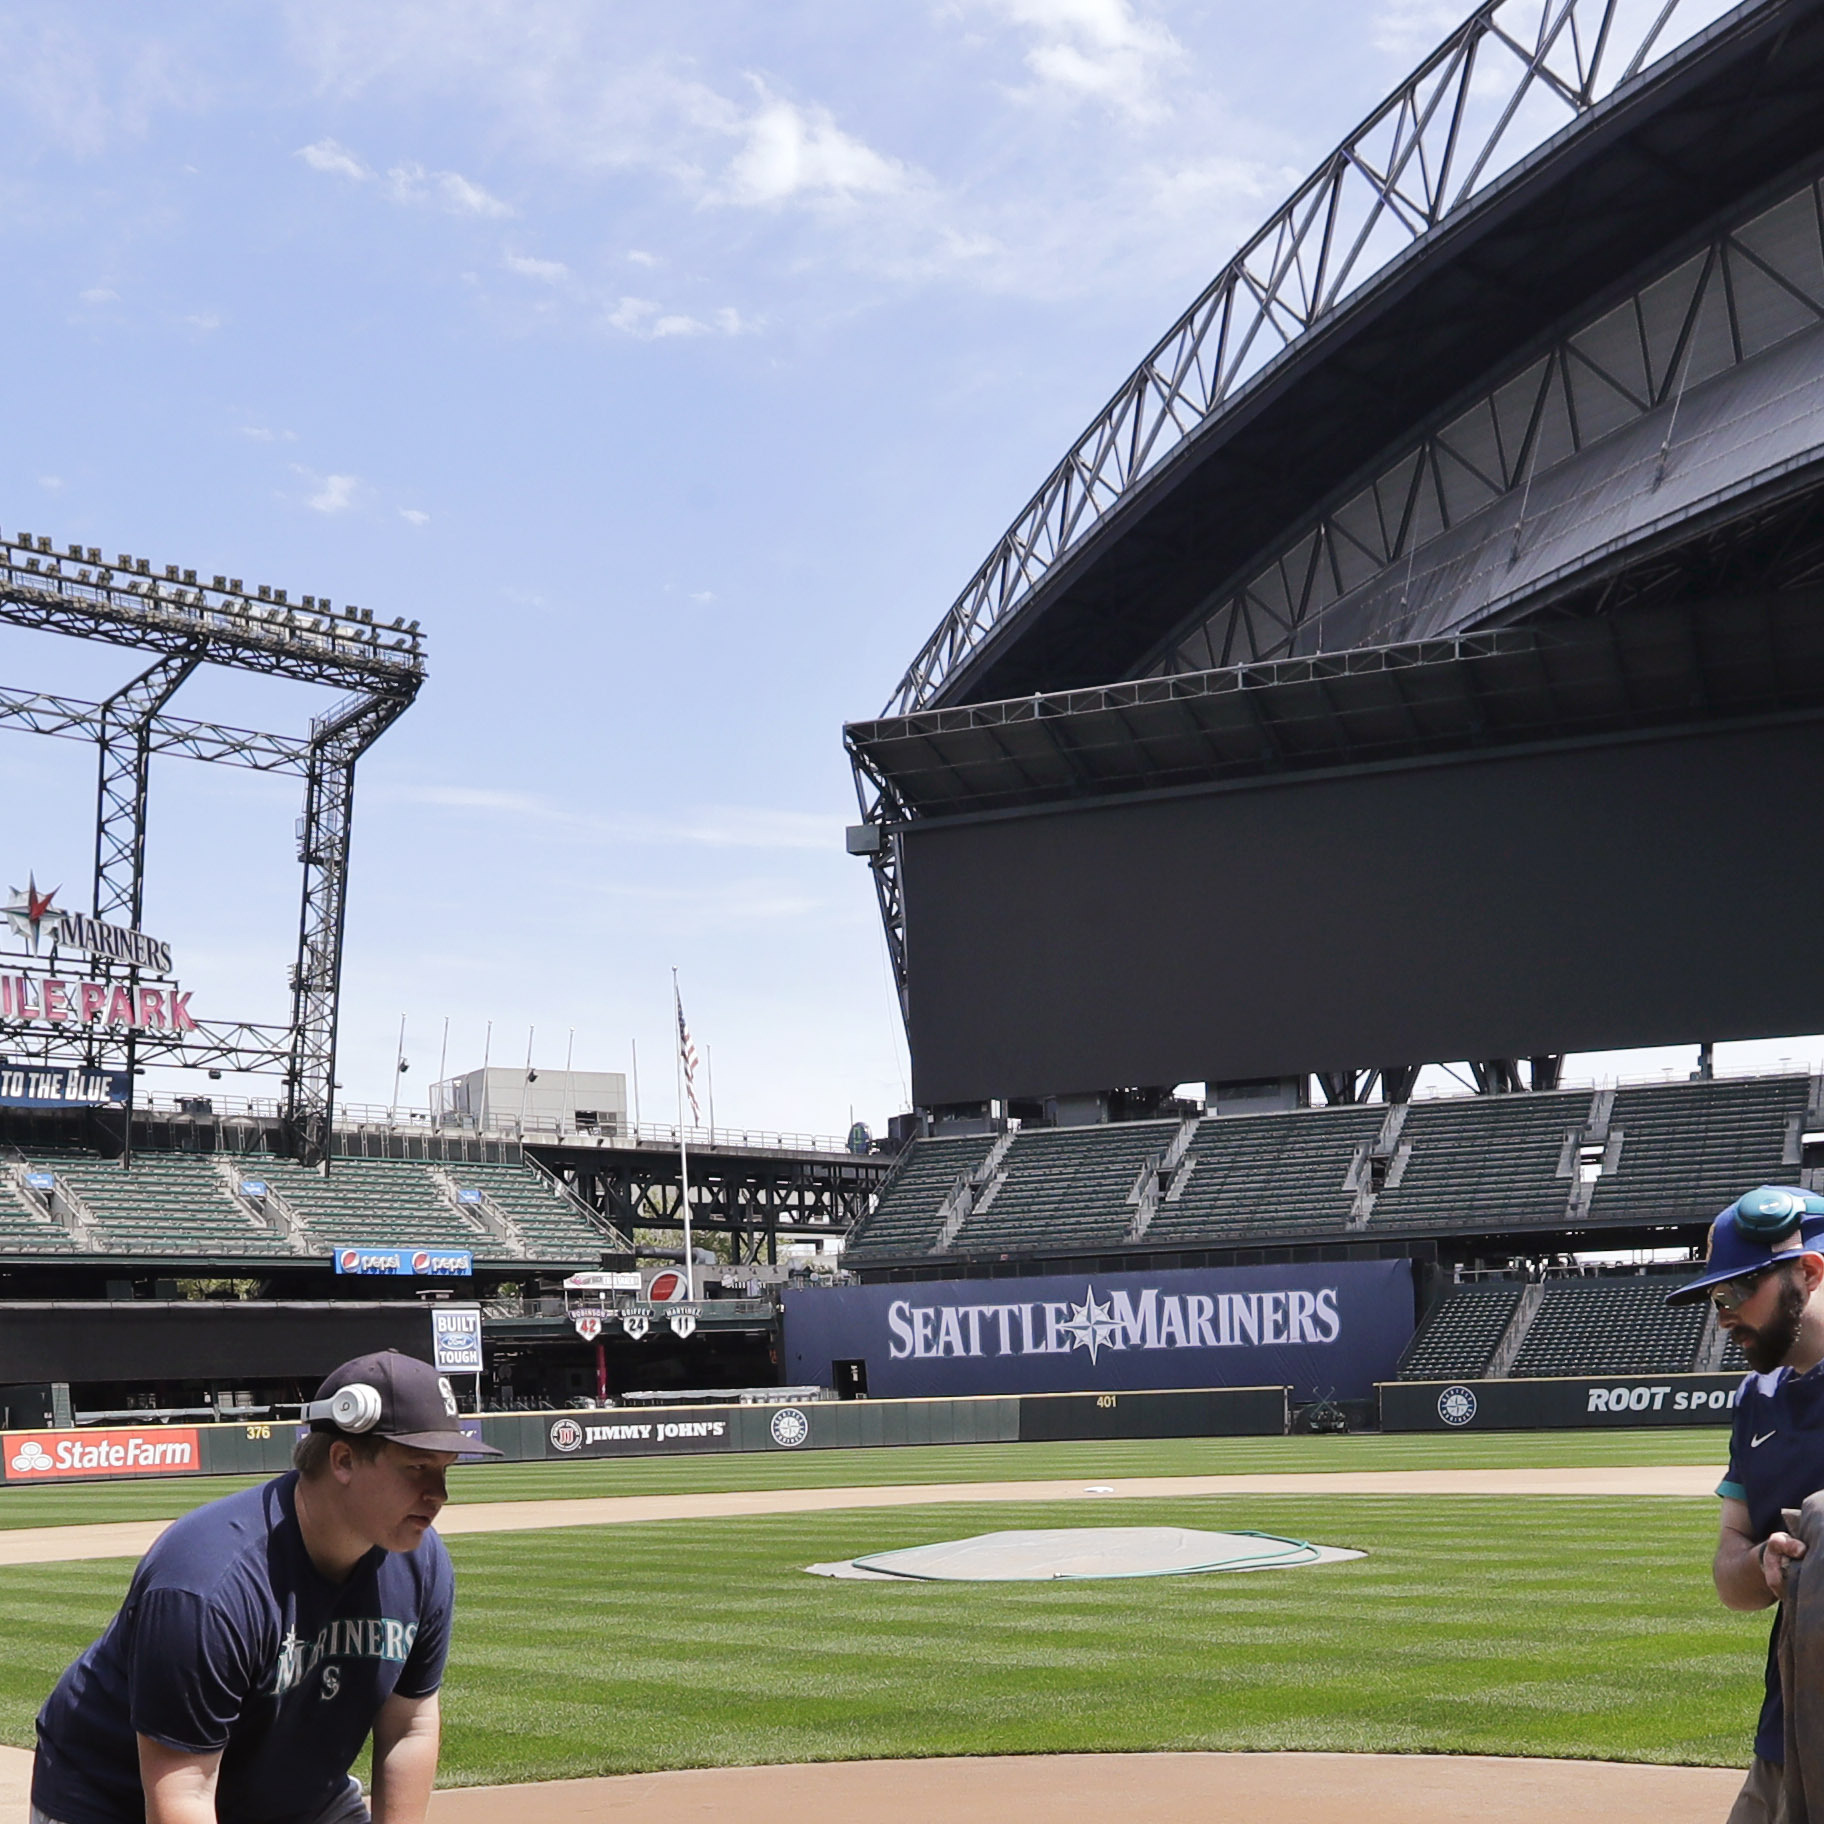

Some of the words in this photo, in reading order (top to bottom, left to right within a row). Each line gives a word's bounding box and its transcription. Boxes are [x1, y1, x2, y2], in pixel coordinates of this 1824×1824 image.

[56, 910, 173, 975] MARINERS
[78, 978, 198, 1032] PARK
[0, 1066, 24, 1098] TO
[28, 1072, 64, 1099] THE
[65, 1070, 113, 1101] BLUE
[361, 1253, 401, 1271] pepsi
[431, 1256, 470, 1273] pepsi
[437, 1316, 476, 1332] BUILT
[580, 1320, 597, 1333] 42
[629, 1318, 645, 1332] 24
[678, 1317, 689, 1331] 11
[888, 1300, 1072, 1360] SEATTLE
[1109, 1287, 1342, 1350] MARINERS
[439, 1350, 478, 1364] TOUGH
[1097, 1396, 1116, 1408] 401
[1587, 1386, 1671, 1412] ROOT
[1673, 1390, 1738, 1409] SPO
[247, 1426, 270, 1439] 376
[585, 1425, 652, 1444] JIMMY
[656, 1422, 725, 1442] JOHN'S
[321, 1666, 340, 1700] S
